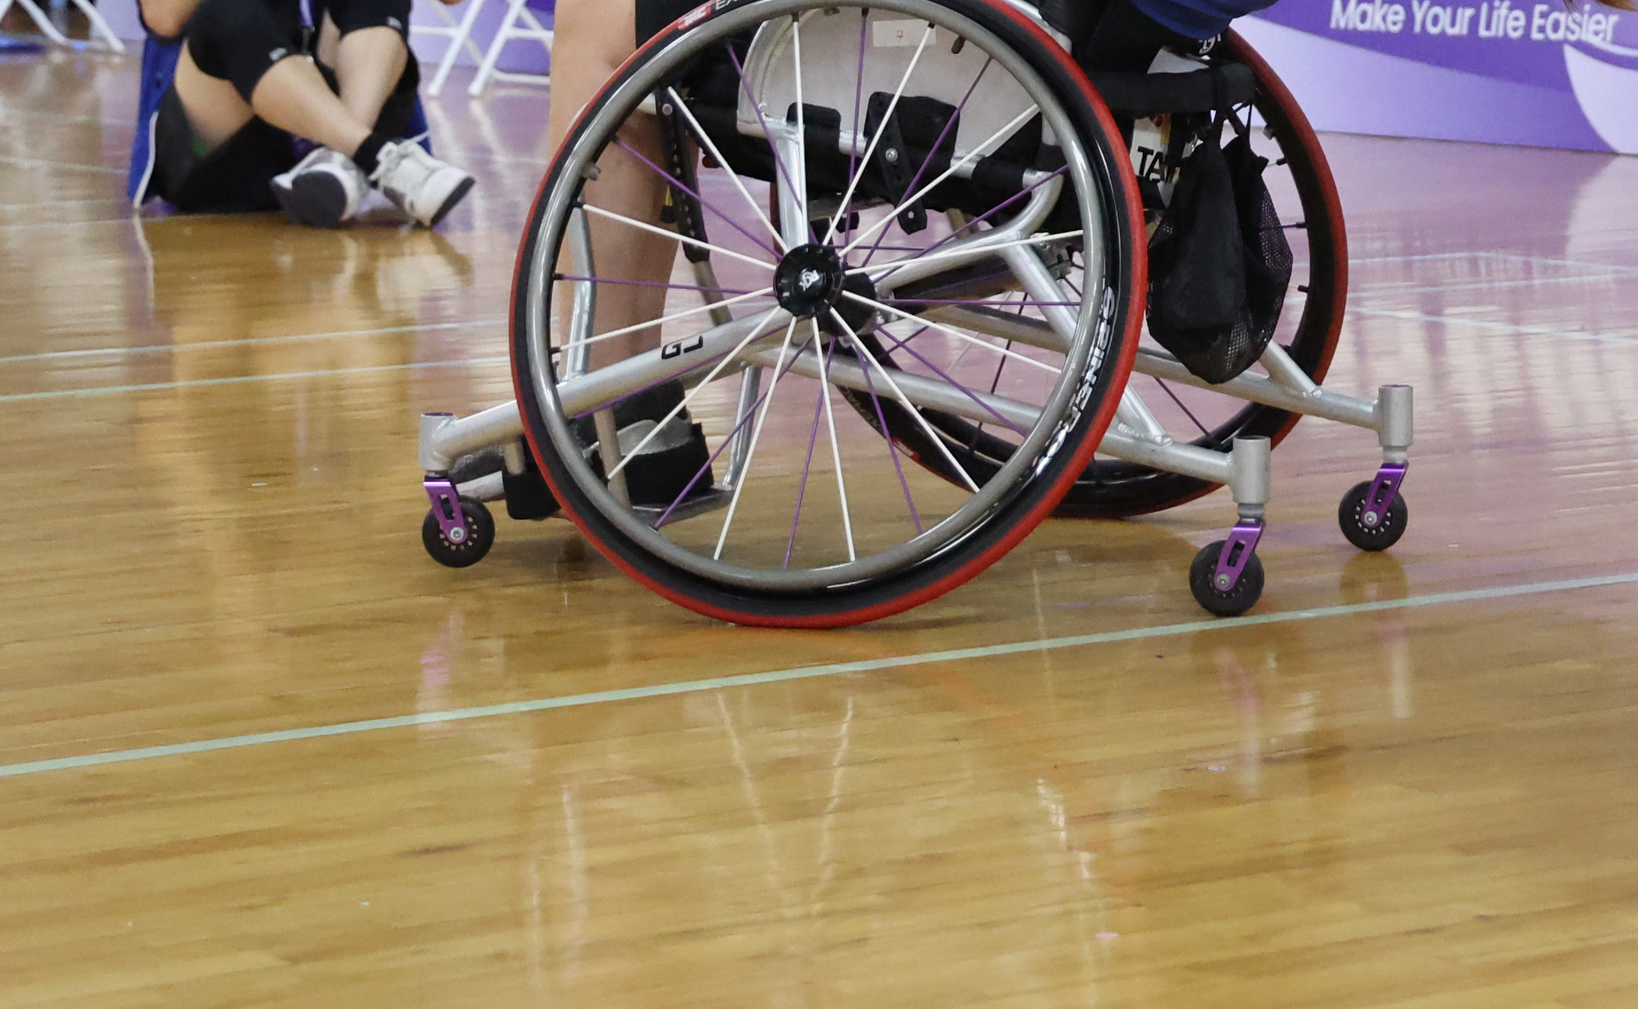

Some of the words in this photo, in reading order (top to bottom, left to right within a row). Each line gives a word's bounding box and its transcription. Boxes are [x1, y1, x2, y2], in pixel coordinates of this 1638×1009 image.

[1411, 0, 1474, 36] Your
[1477, 0, 1525, 38] Life
[1530, 3, 1619, 44] Easier
